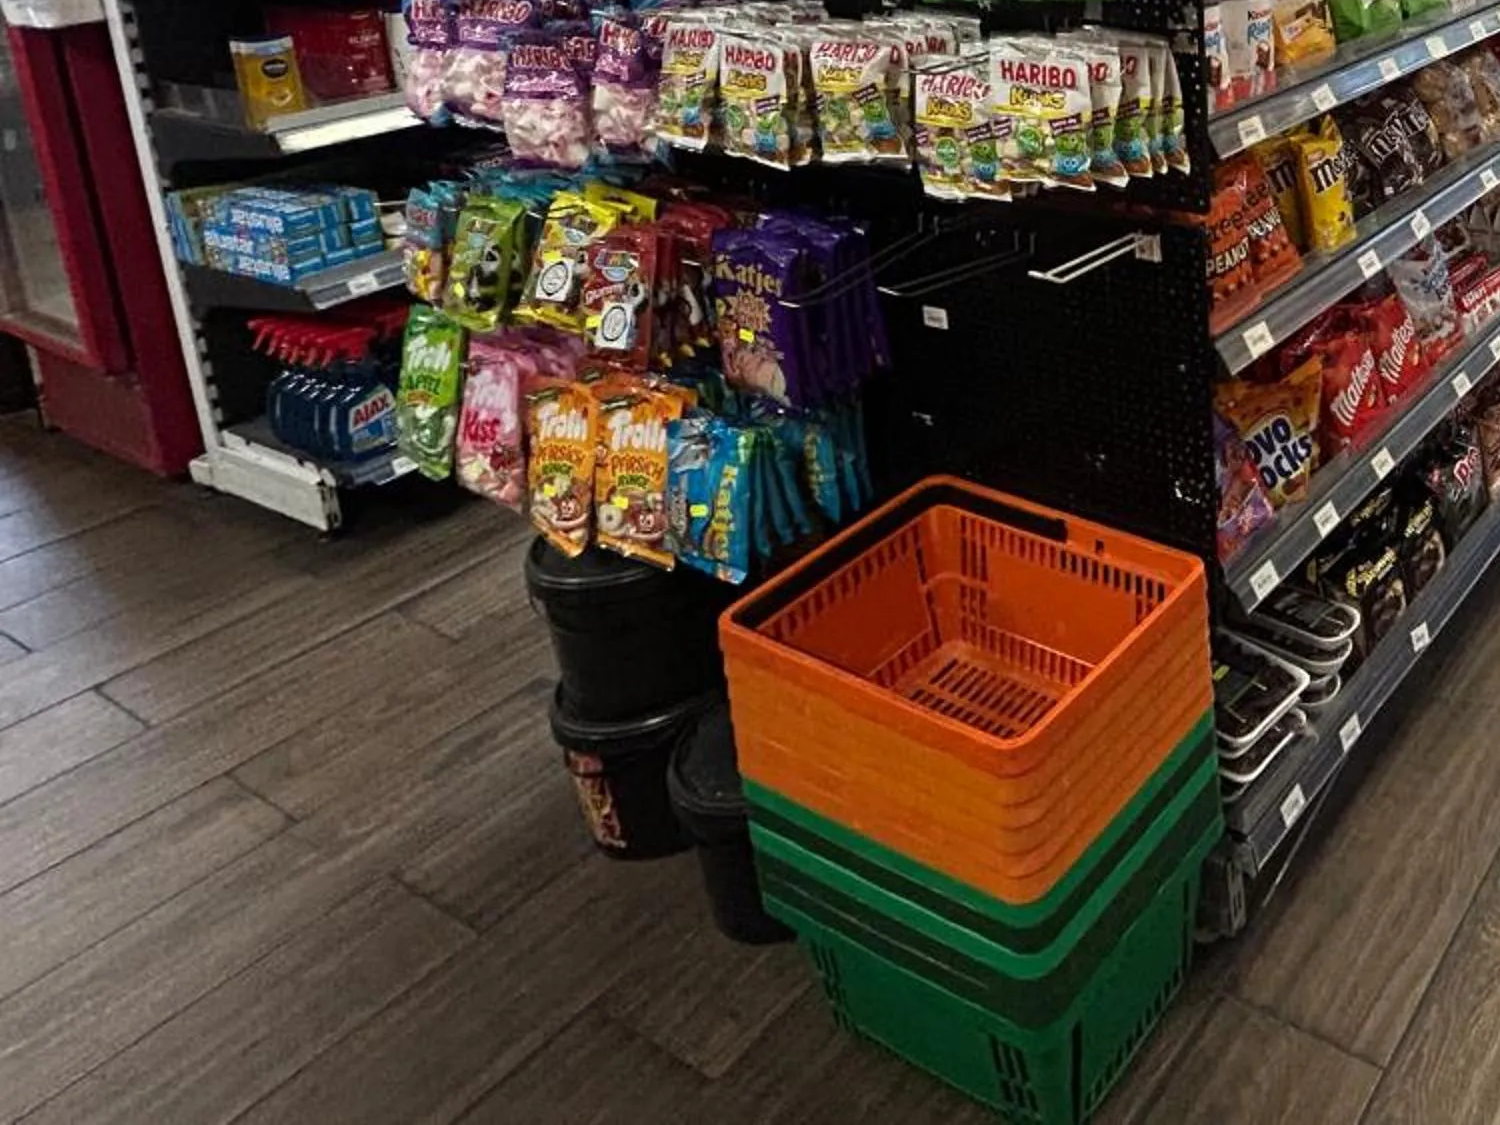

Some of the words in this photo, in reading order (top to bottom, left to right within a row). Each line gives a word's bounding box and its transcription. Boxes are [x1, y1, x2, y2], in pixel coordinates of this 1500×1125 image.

[1000, 59, 1077, 89] HARIBO
[713, 252, 785, 299] Katjes
[349, 392, 392, 429] AJAX
[463, 407, 501, 443] Kiss
[537, 401, 589, 442] Trolli
[607, 410, 667, 453] Trolli
